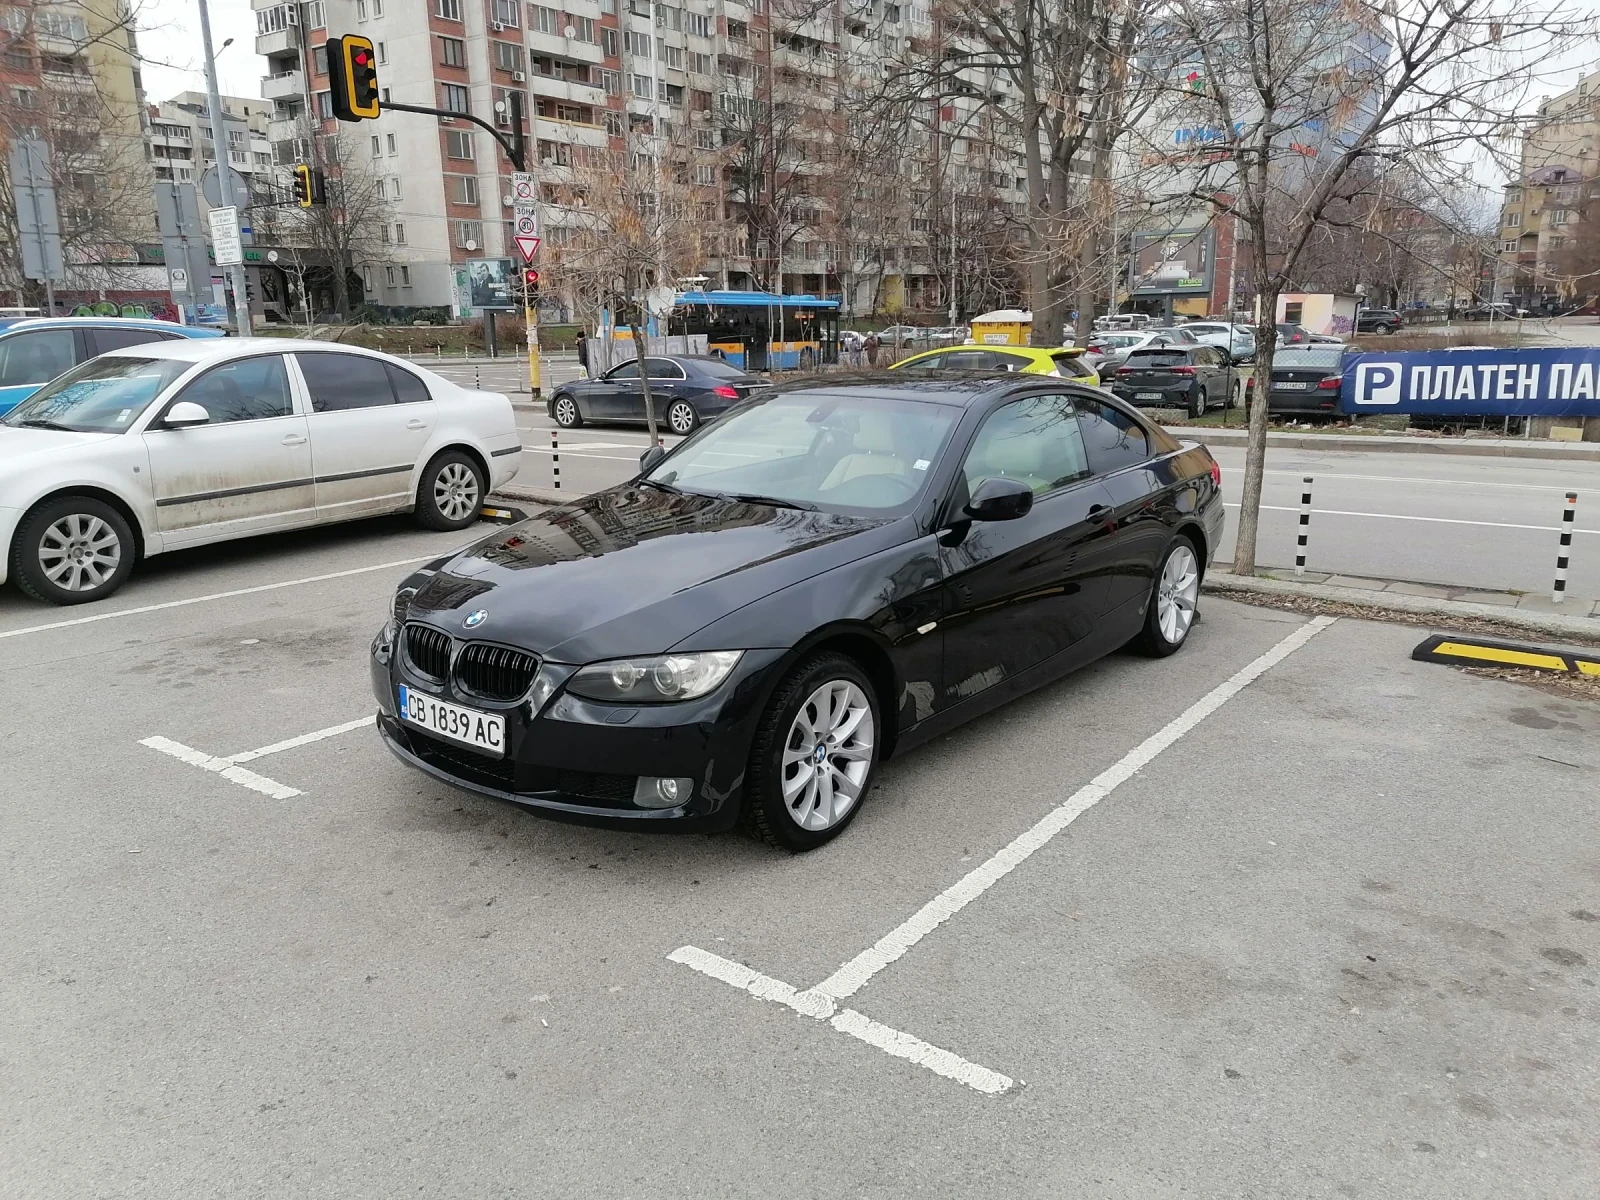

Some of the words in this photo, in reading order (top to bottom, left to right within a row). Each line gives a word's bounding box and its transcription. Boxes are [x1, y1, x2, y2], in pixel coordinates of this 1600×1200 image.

[514, 174, 533, 182] ЗОНА
[516, 207, 536, 216] ЗОНА
[521, 221, 532, 231] 30
[1363, 367, 1395, 401] P
[1409, 363, 1541, 400] ПЛАТЕН
[1548, 363, 1600, 400] ПА
[408, 694, 426, 723] CB
[430, 703, 470, 738] 1839
[475, 717, 500, 747] AC
